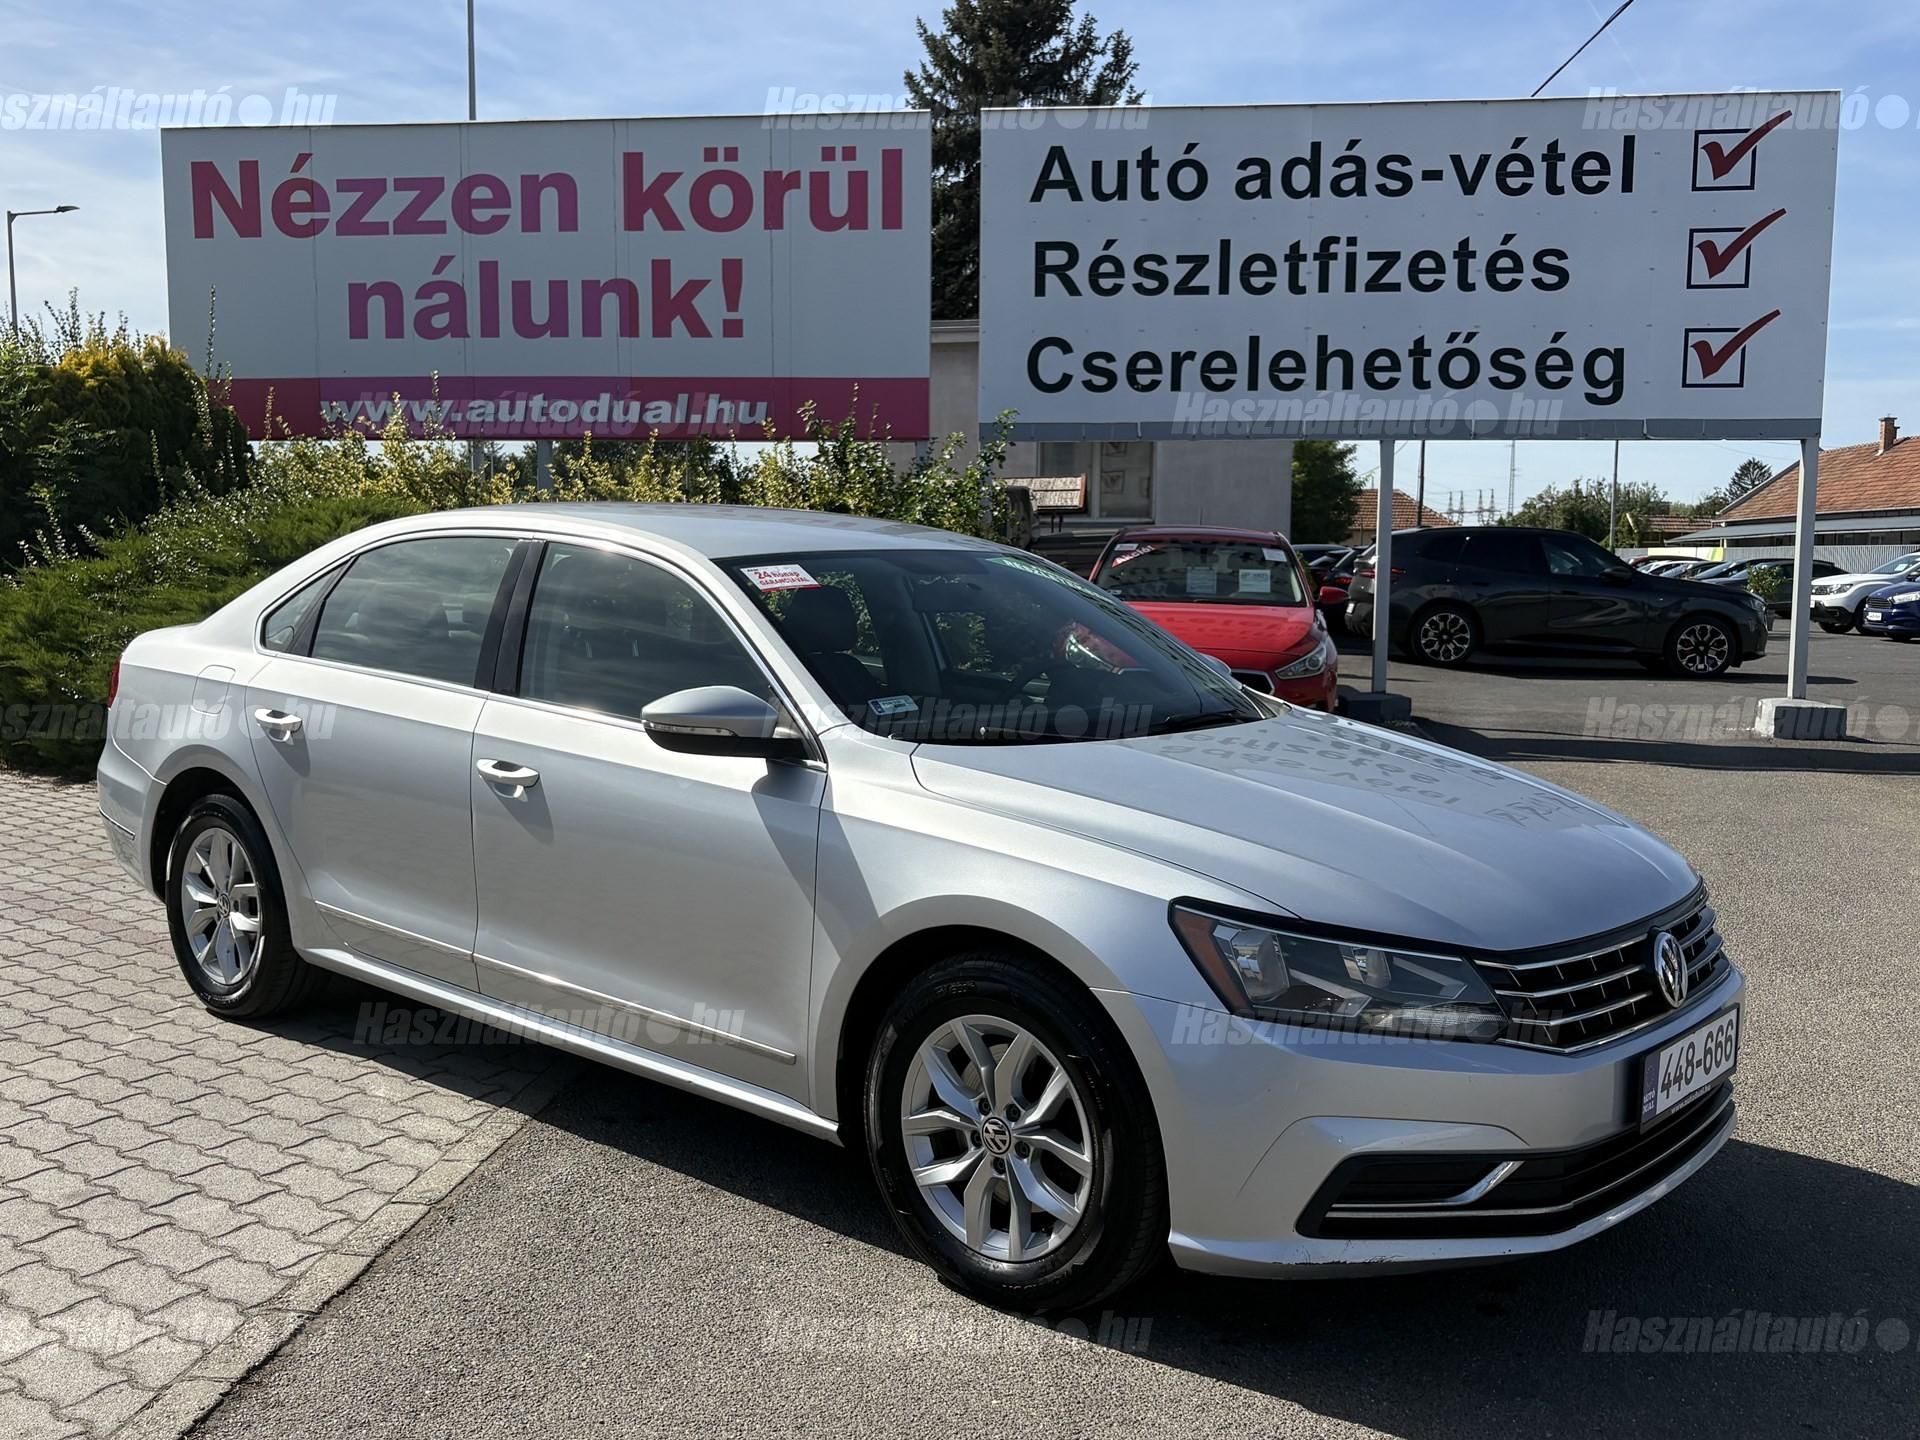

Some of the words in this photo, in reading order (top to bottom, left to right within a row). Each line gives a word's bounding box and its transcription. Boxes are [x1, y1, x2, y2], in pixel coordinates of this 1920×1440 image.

[190, 152, 578, 239] Nézzen
[623, 146, 903, 232] körül
[1030, 143, 1208, 202] Autó
[1235, 135, 1635, 200] adás-vétel
[348, 255, 744, 340] nálunk!
[1035, 234, 1569, 297] Részletfizetés
[1027, 332, 1624, 404] Cserelehetőség
[754, 570, 772, 580] 24
[1661, 1018, 1734, 1100] 448-666
